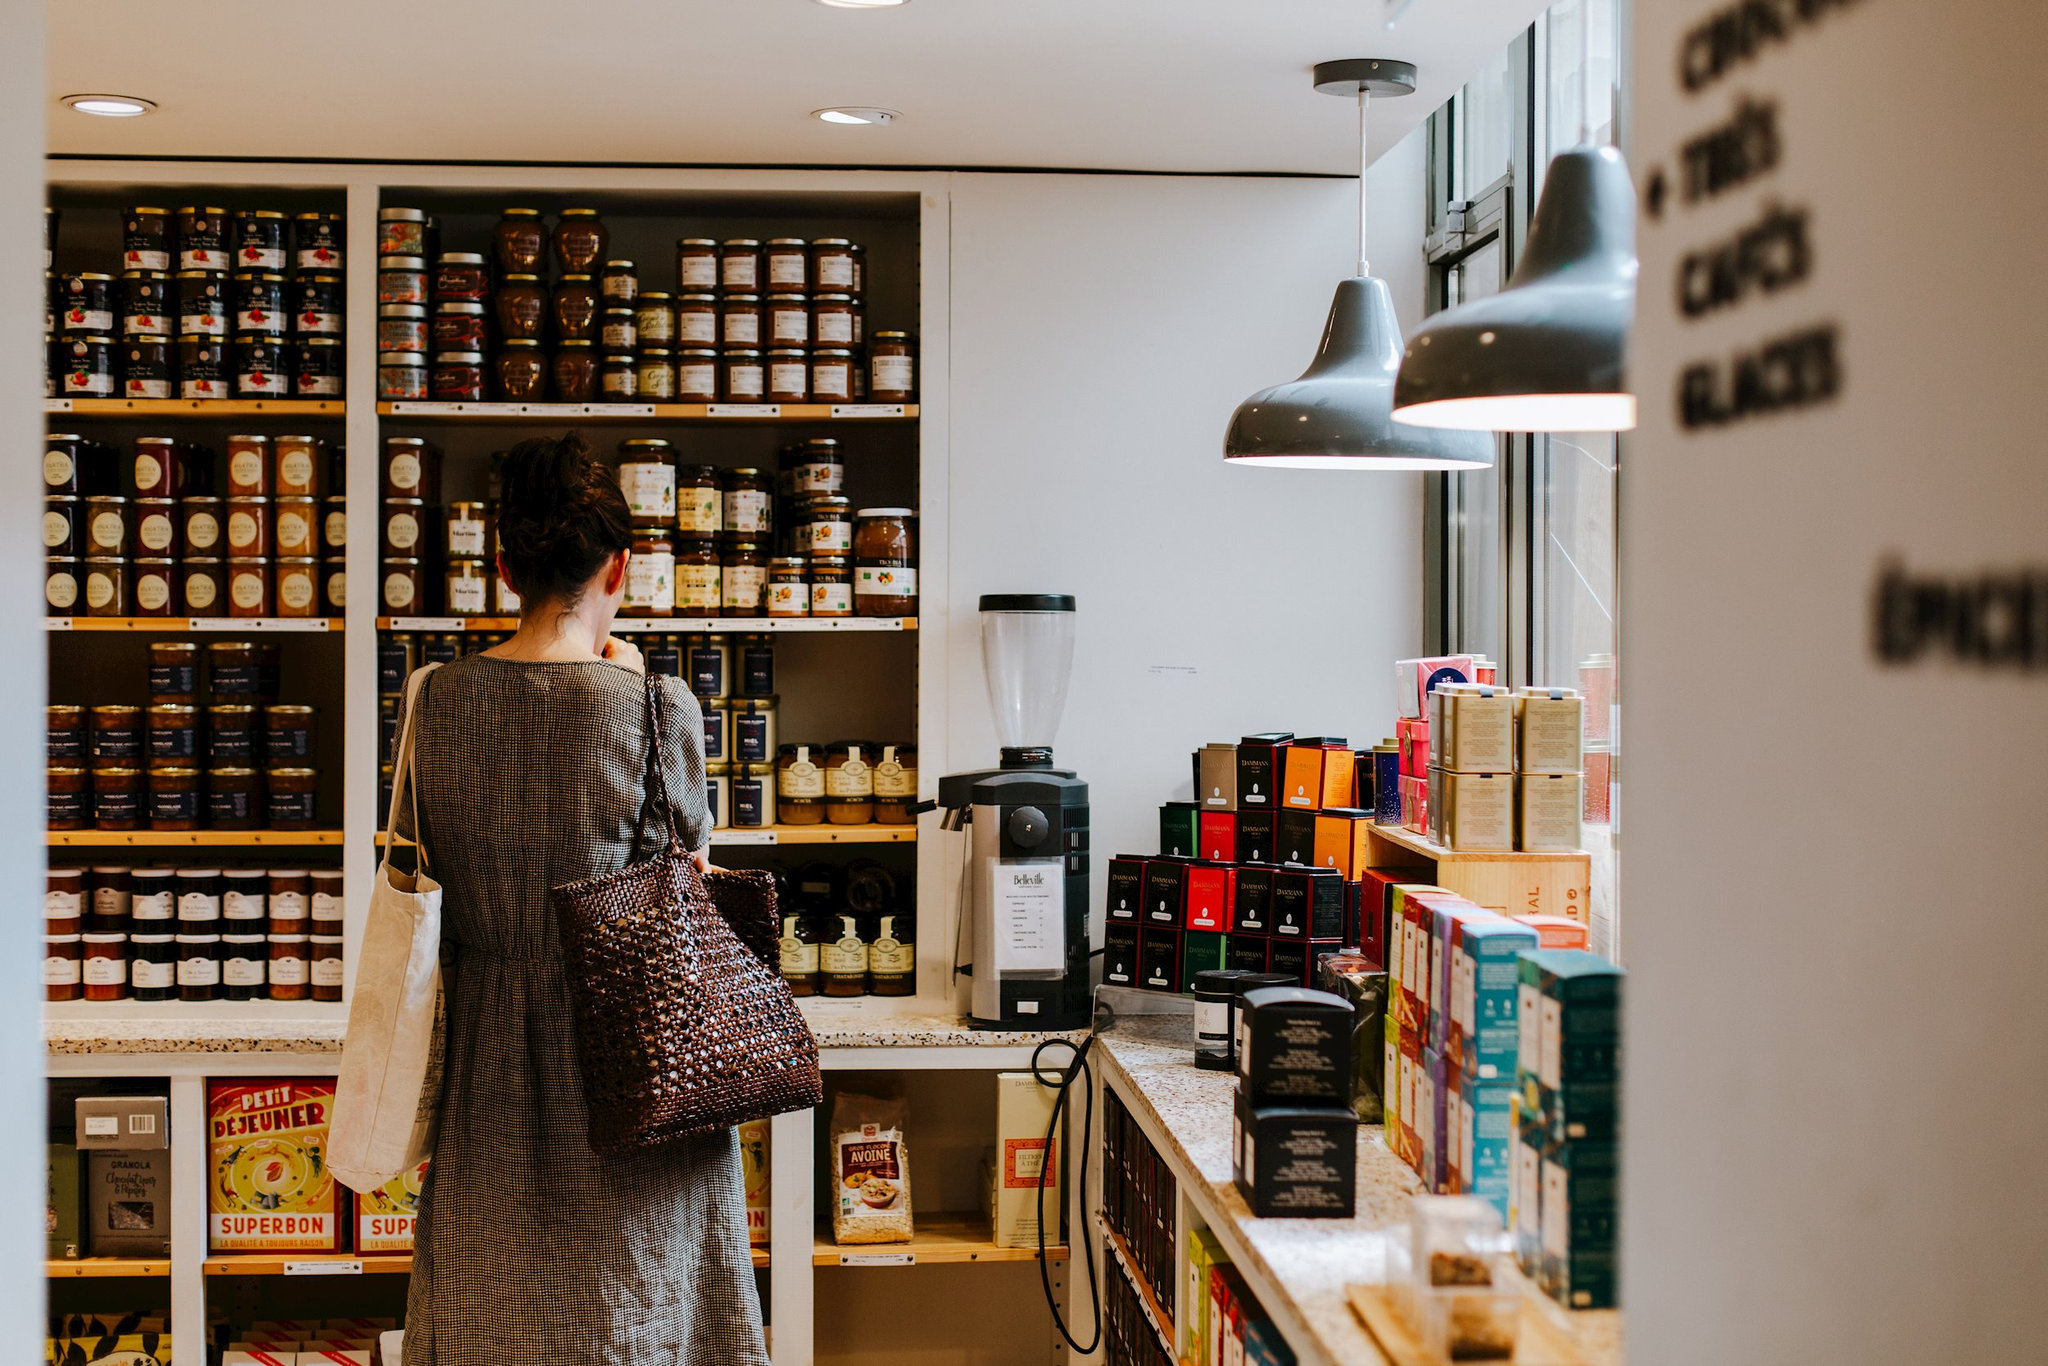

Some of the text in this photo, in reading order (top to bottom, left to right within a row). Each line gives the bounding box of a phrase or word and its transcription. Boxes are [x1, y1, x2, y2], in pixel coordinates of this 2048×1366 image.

[1013, 872, 1045, 886] Belleville
[214, 1102, 325, 1138] DÉJEUNER
[851, 1148, 892, 1164] AVOINE
[111, 1160, 152, 1169] GRANOLA
[221, 1216, 324, 1235] SUPERBON
